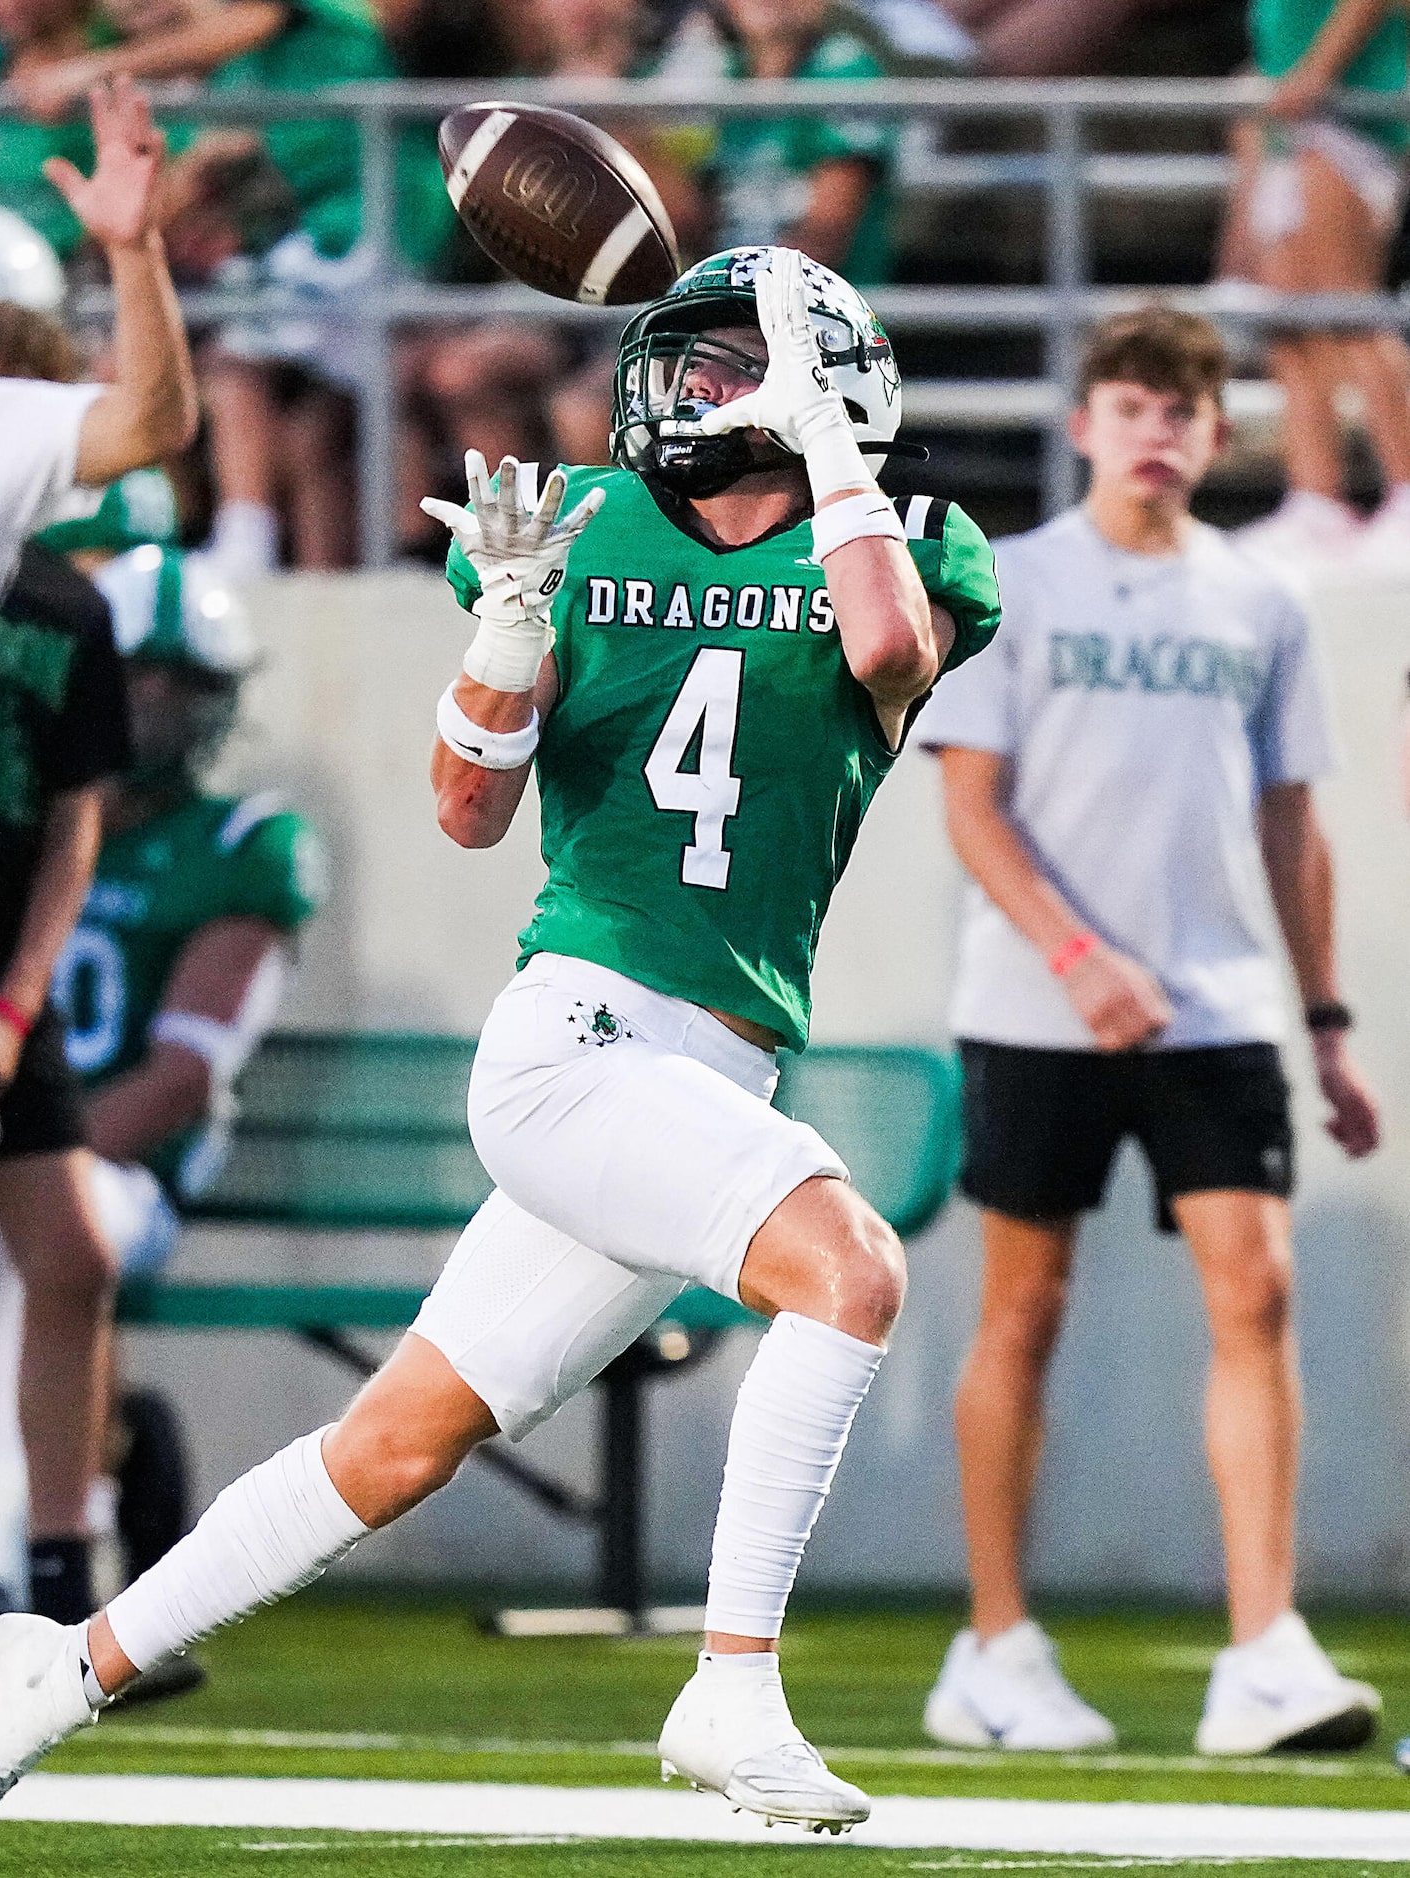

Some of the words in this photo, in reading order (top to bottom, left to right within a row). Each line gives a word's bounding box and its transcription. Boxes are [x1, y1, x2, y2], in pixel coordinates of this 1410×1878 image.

[586, 576, 836, 633] DRAGONS
[1048, 627, 1266, 703] DRAGON
[642, 645, 747, 893] 4
